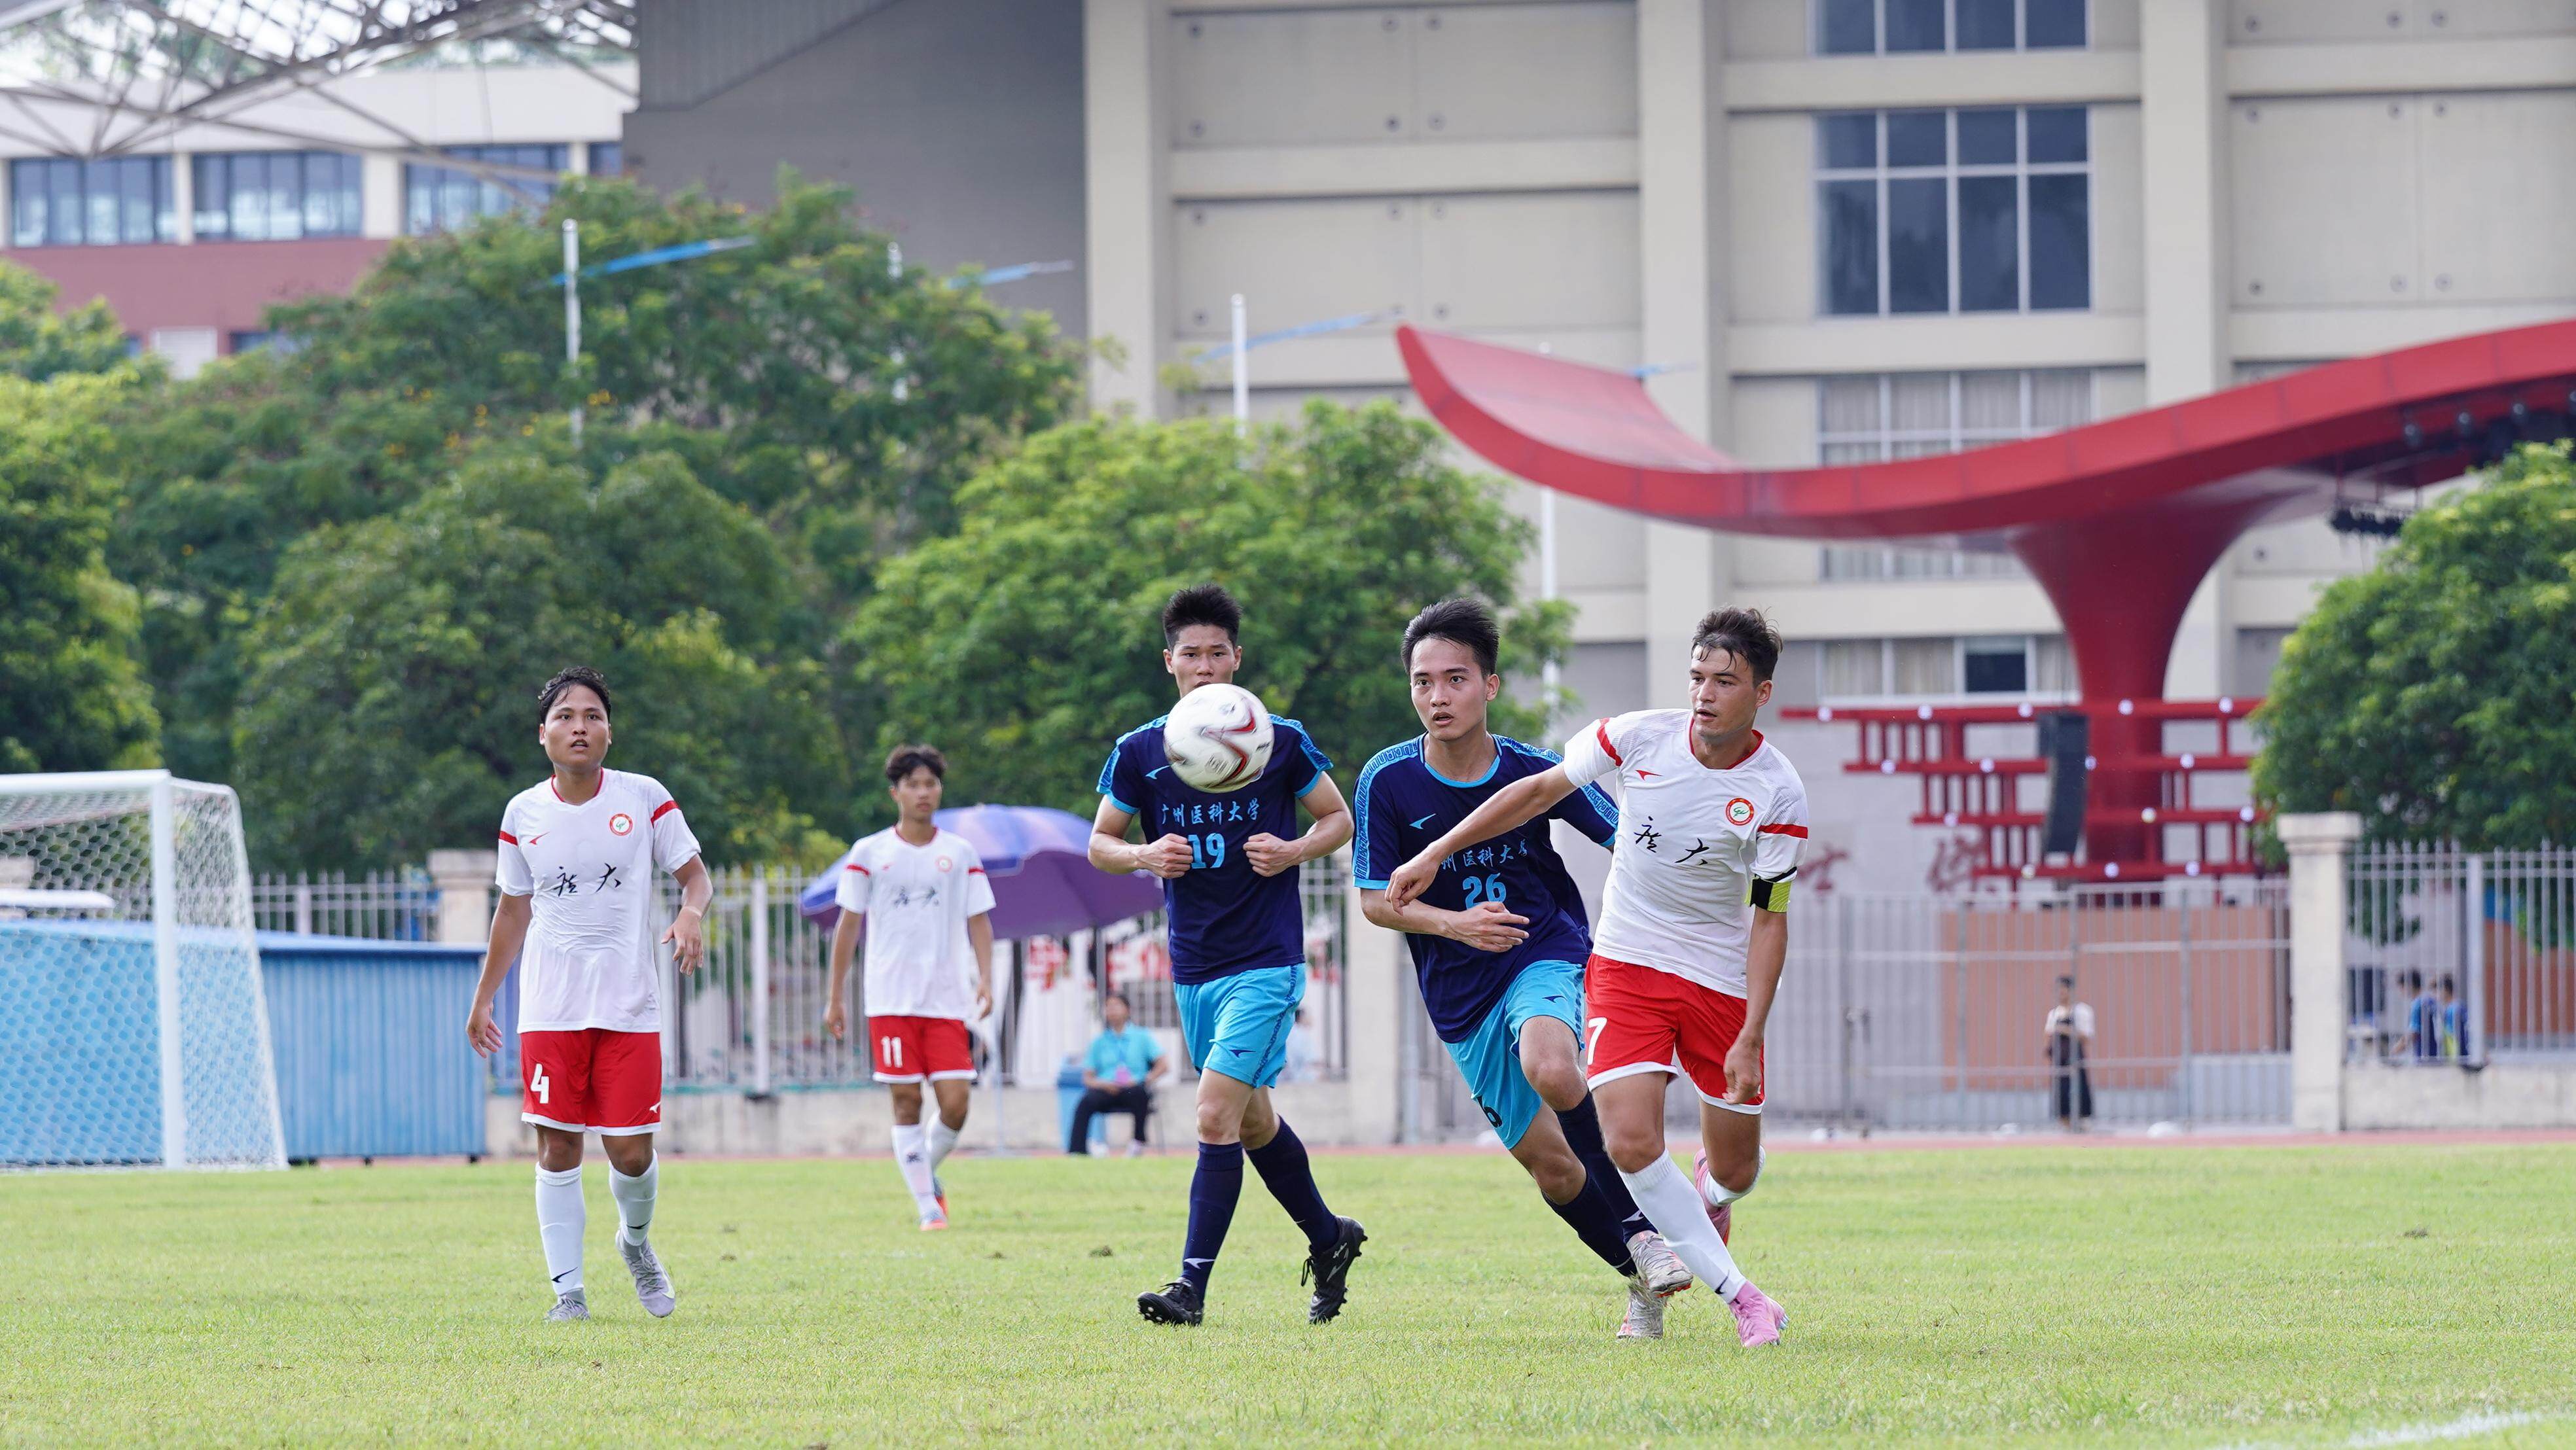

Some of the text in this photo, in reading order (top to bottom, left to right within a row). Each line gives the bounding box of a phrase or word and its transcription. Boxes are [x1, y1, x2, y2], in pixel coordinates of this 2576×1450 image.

[1162, 798, 1260, 827] 广州医科大学
[1188, 833, 1225, 869] 19
[1441, 839, 1529, 872] 州医科大学
[1462, 872, 1506, 910] 26
[880, 1036, 903, 1067] 11
[1587, 1017, 1607, 1065] 7
[530, 1063, 550, 1104] 4
